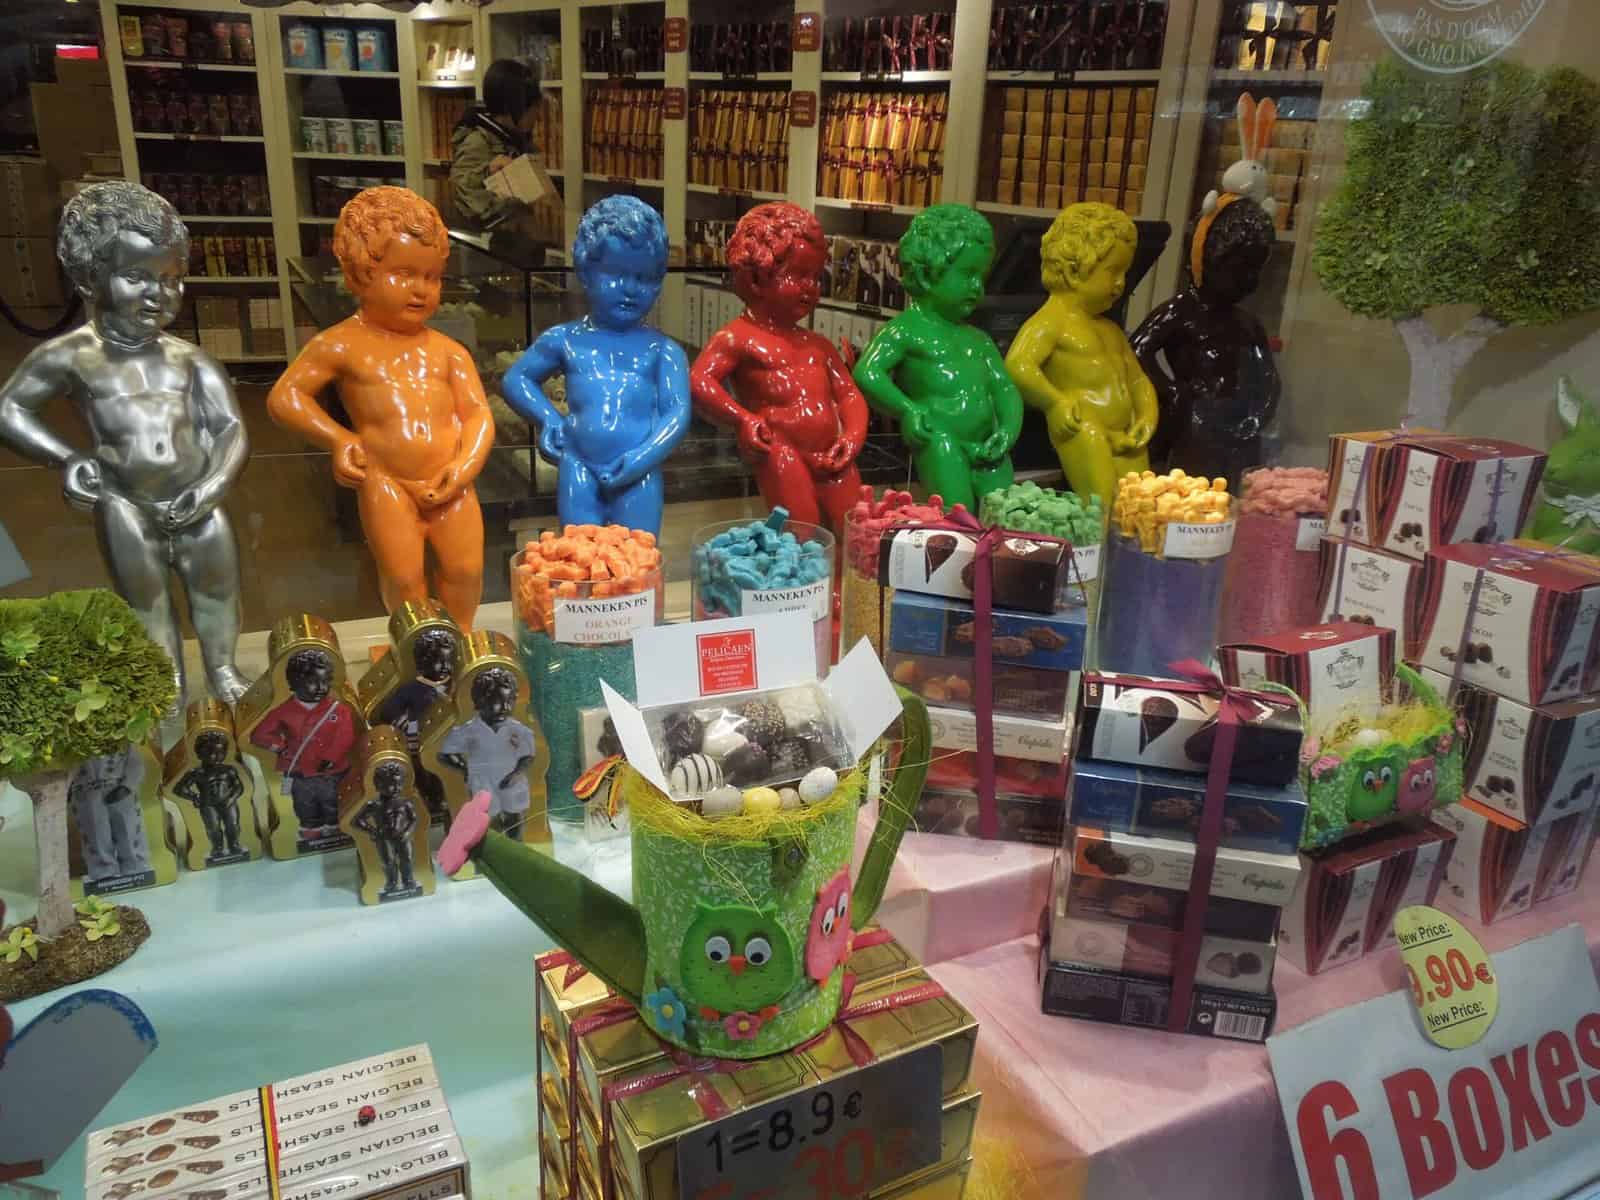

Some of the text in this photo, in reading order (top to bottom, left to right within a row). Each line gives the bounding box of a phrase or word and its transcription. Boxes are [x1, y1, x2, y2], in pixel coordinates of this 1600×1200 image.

[566, 599, 631, 613] MANNEKEN
[753, 589, 811, 601] MANNEKEN
[1399, 923, 1451, 945] New Price:
[1427, 1001, 1485, 1027] New Price:
[342, 1055, 417, 1081] BELGIAN
[347, 1077, 424, 1105] BELGIAN
[360, 1124, 441, 1154] BELGIAN
[1296, 1079, 1381, 1200] 6
[367, 1149, 449, 1181] BELGIAN
